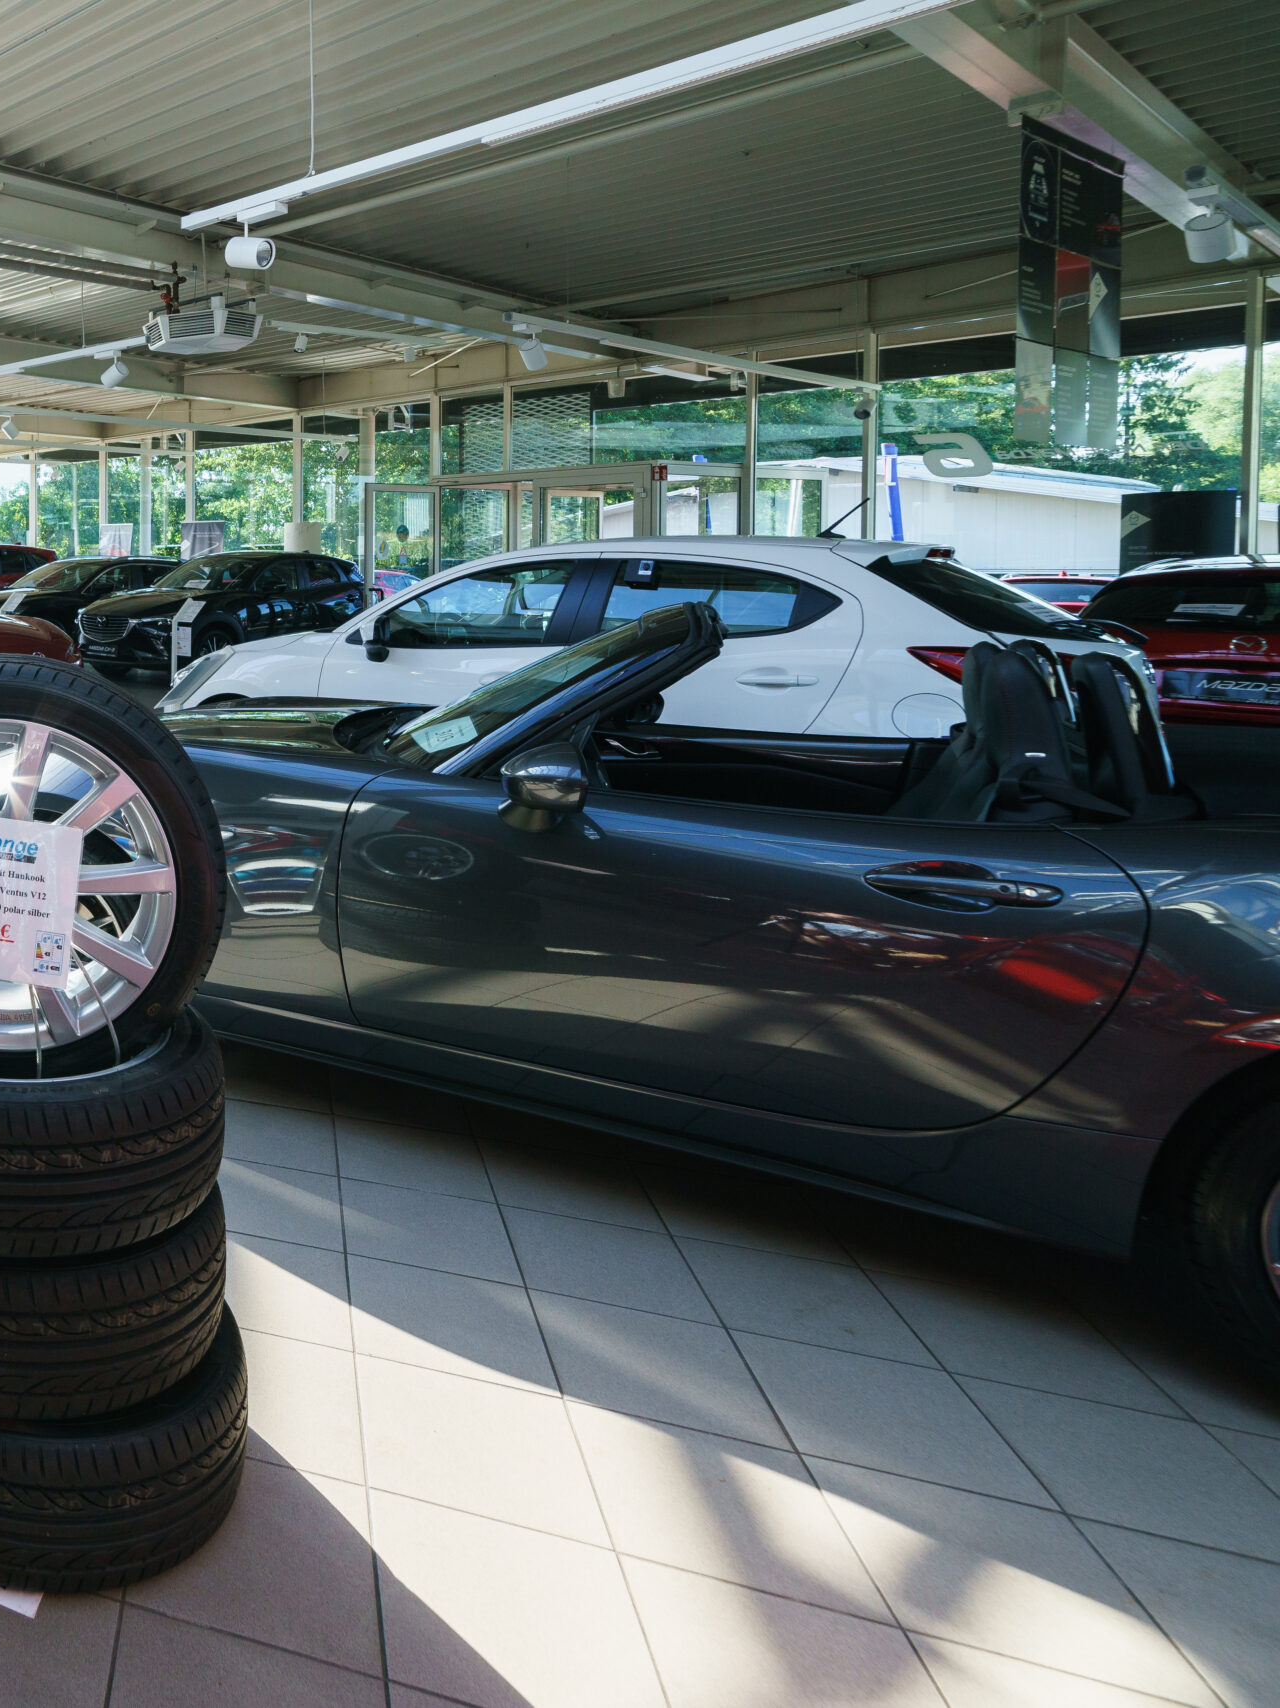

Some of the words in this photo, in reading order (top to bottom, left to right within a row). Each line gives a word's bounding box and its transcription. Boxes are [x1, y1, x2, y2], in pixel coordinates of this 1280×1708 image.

[8, 870, 45, 882] Hankook
[0, 886, 27, 897] Ventus
[30, 891, 46, 900] V12
[3, 904, 25, 916] polar
[27, 908, 50, 918] silber
[0, 923, 11, 938] €
